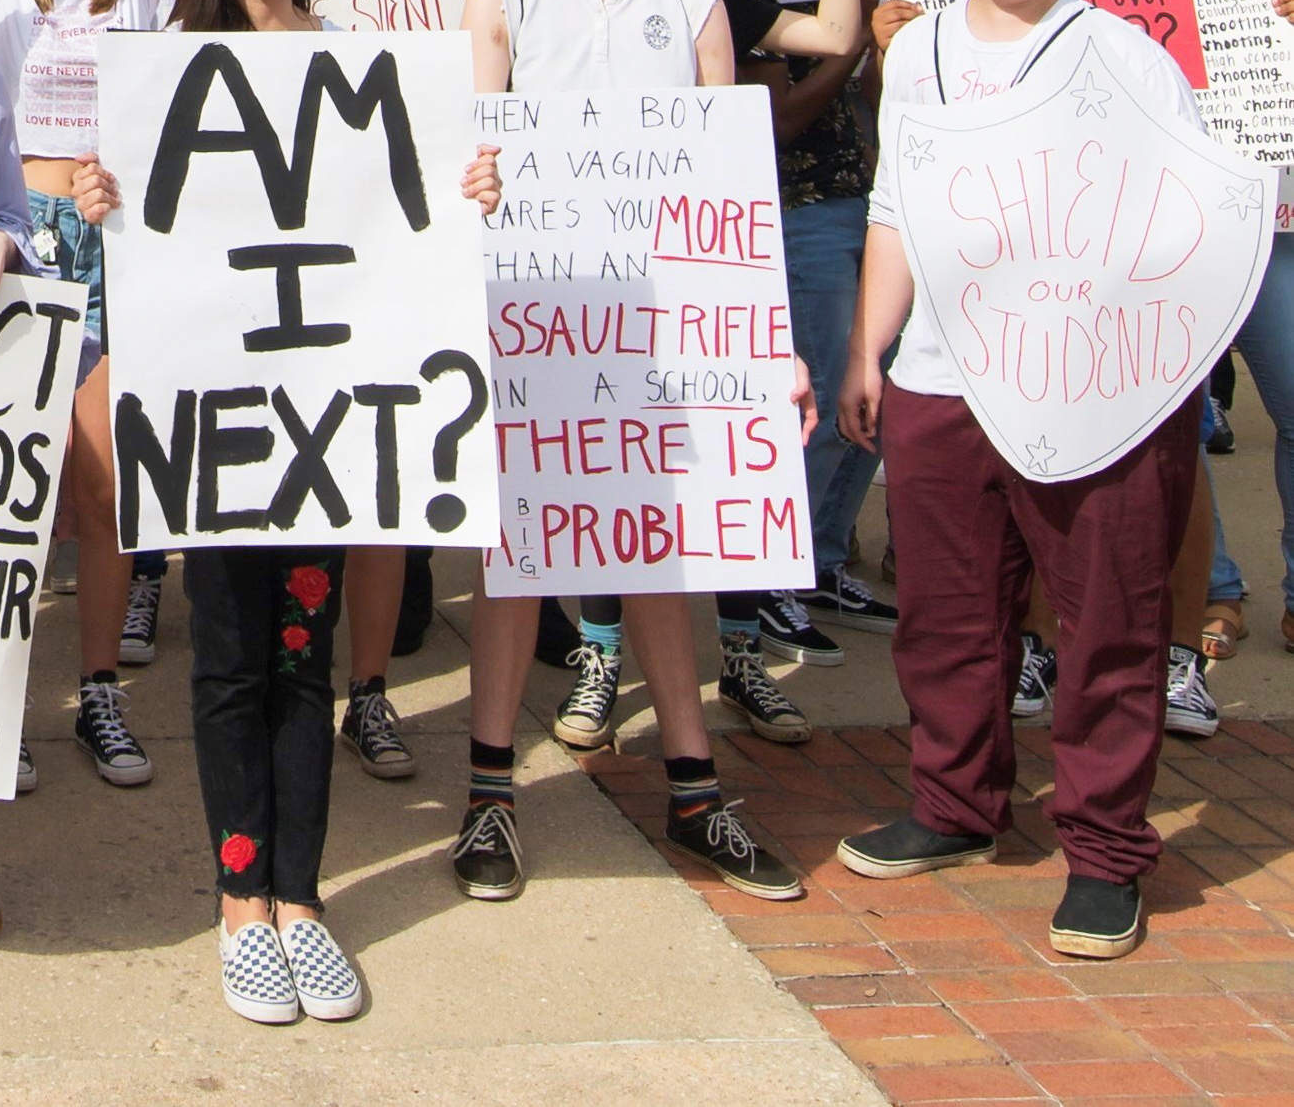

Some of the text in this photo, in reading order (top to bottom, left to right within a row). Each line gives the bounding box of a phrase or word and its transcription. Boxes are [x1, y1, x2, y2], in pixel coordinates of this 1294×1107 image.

[56, 66, 95, 77] NEVER
[61, 117, 93, 128] NEVER
[143, 41, 432, 235] AM
[583, 95, 717, 132] A BOY
[515, 148, 694, 181] A VAGINA
[605, 194, 774, 262] YOU MORE
[600, 251, 649, 279] AN
[1027, 279, 1093, 306] OUR
[227, 243, 358, 353] I
[681, 303, 792, 361] RIFLE
[959, 280, 1198, 405] STUDENTS
[494, 369, 768, 409] IN A SCHOOL,
[113, 349, 490, 551] NEXT?
[495, 415, 779, 478] THERE IS
[542, 496, 806, 569] PROBLEM.
